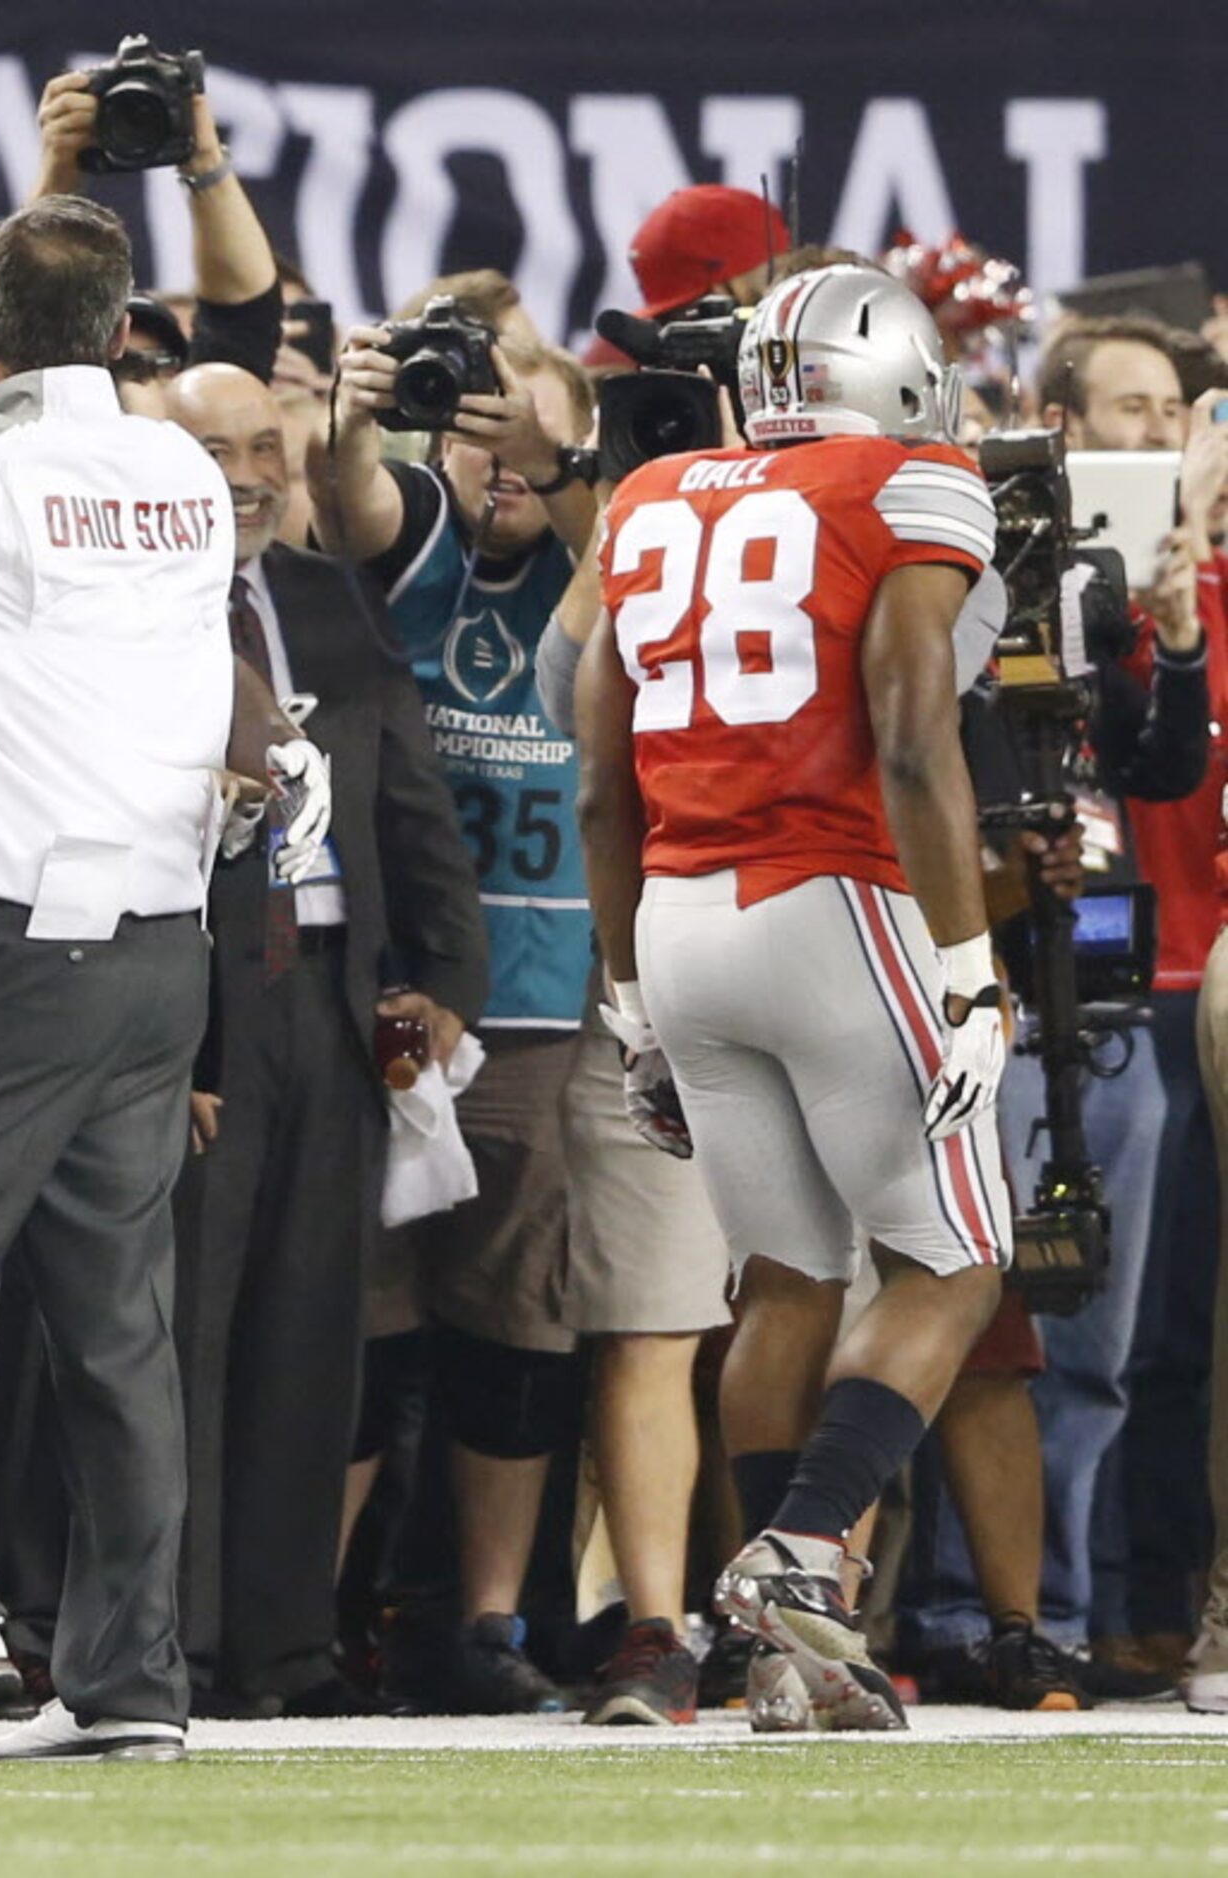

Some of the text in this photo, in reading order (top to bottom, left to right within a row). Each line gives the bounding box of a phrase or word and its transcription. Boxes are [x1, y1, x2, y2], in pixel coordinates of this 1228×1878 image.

[678, 454, 781, 492] BALL
[43, 495, 127, 550] OHIO
[612, 489, 820, 733] 28
[435, 731, 574, 764] MPIONSHIP
